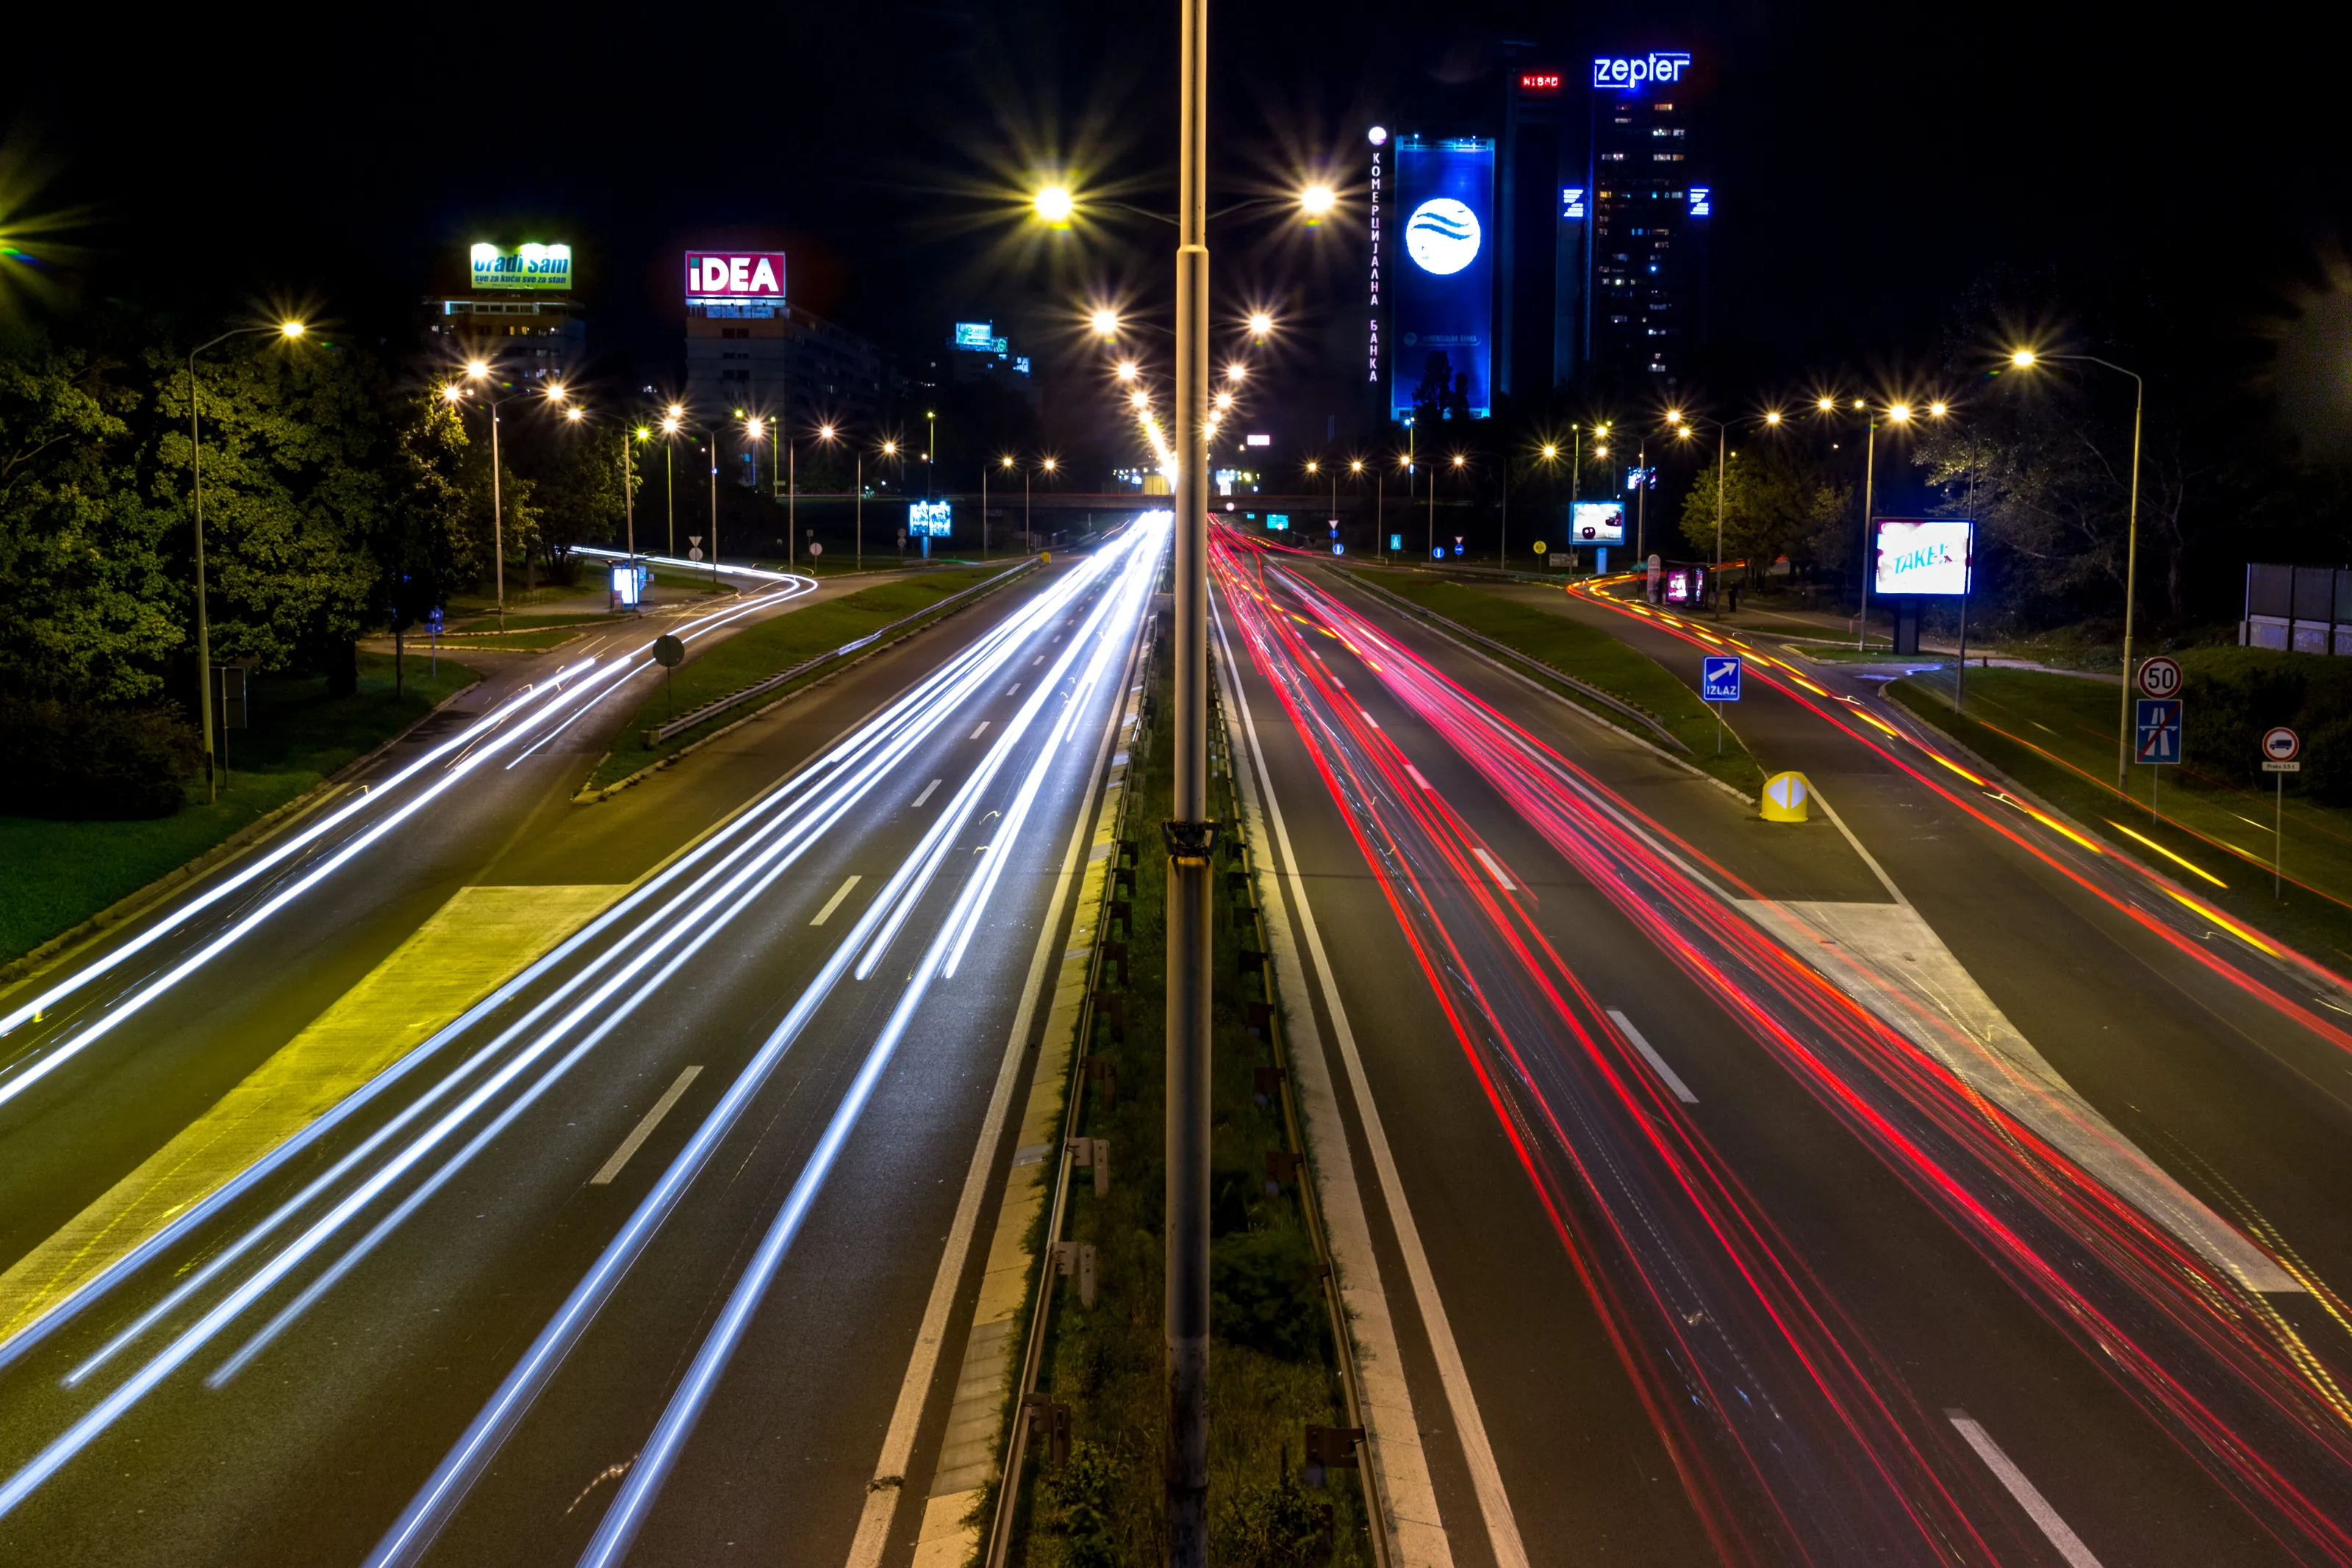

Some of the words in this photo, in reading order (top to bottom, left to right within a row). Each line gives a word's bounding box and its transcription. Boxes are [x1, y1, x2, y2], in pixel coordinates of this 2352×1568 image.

[1594, 53, 1690, 88] zepter
[1370, 152, 1380, 306] КОМЕРЦИЈАЛНА
[1369, 320, 1378, 381] БАНКА
[1894, 543, 1943, 574] TAKE!
[1707, 686, 1737, 695] IZLAZ
[2148, 667, 2174, 689] 50
